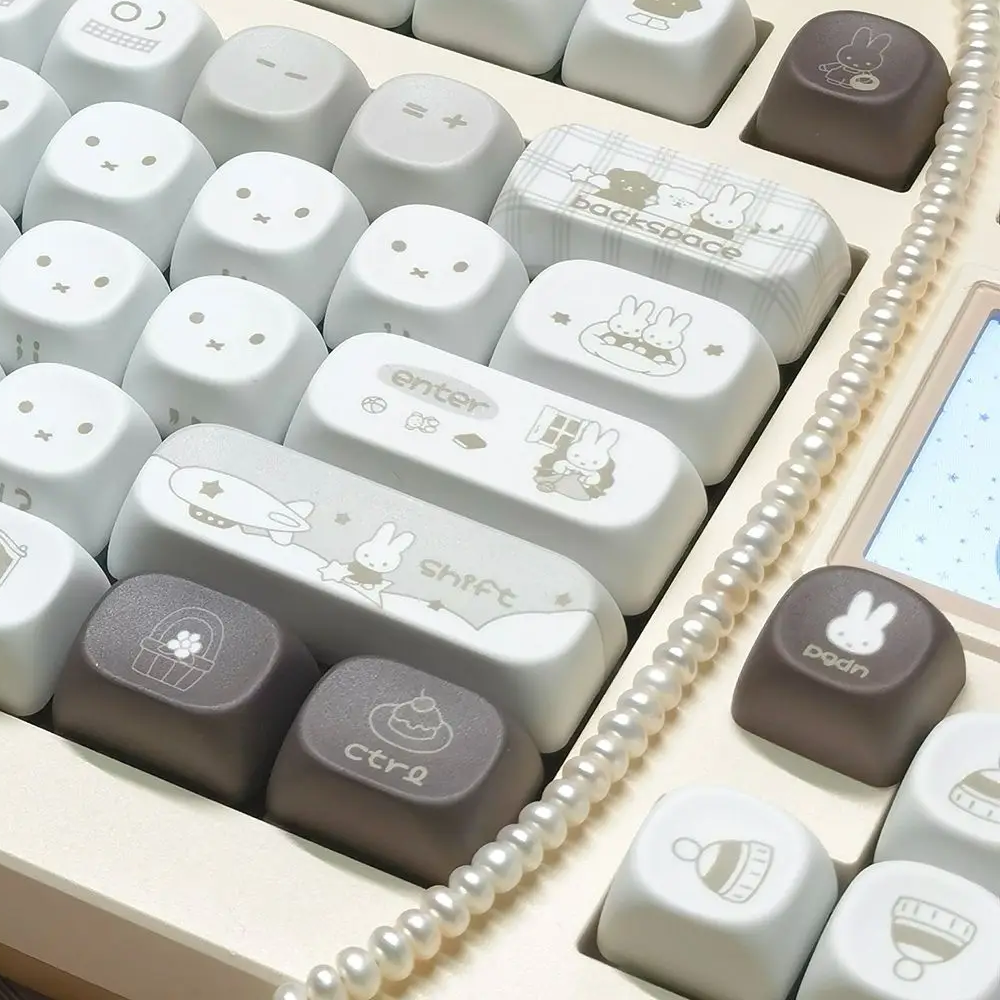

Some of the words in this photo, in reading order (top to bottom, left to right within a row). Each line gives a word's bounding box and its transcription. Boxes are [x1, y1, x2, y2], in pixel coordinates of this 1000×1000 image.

[571, 193, 743, 261] backspace
[391, 369, 491, 412] enter
[418, 556, 518, 609] shift
[344, 741, 429, 787] ctrl
